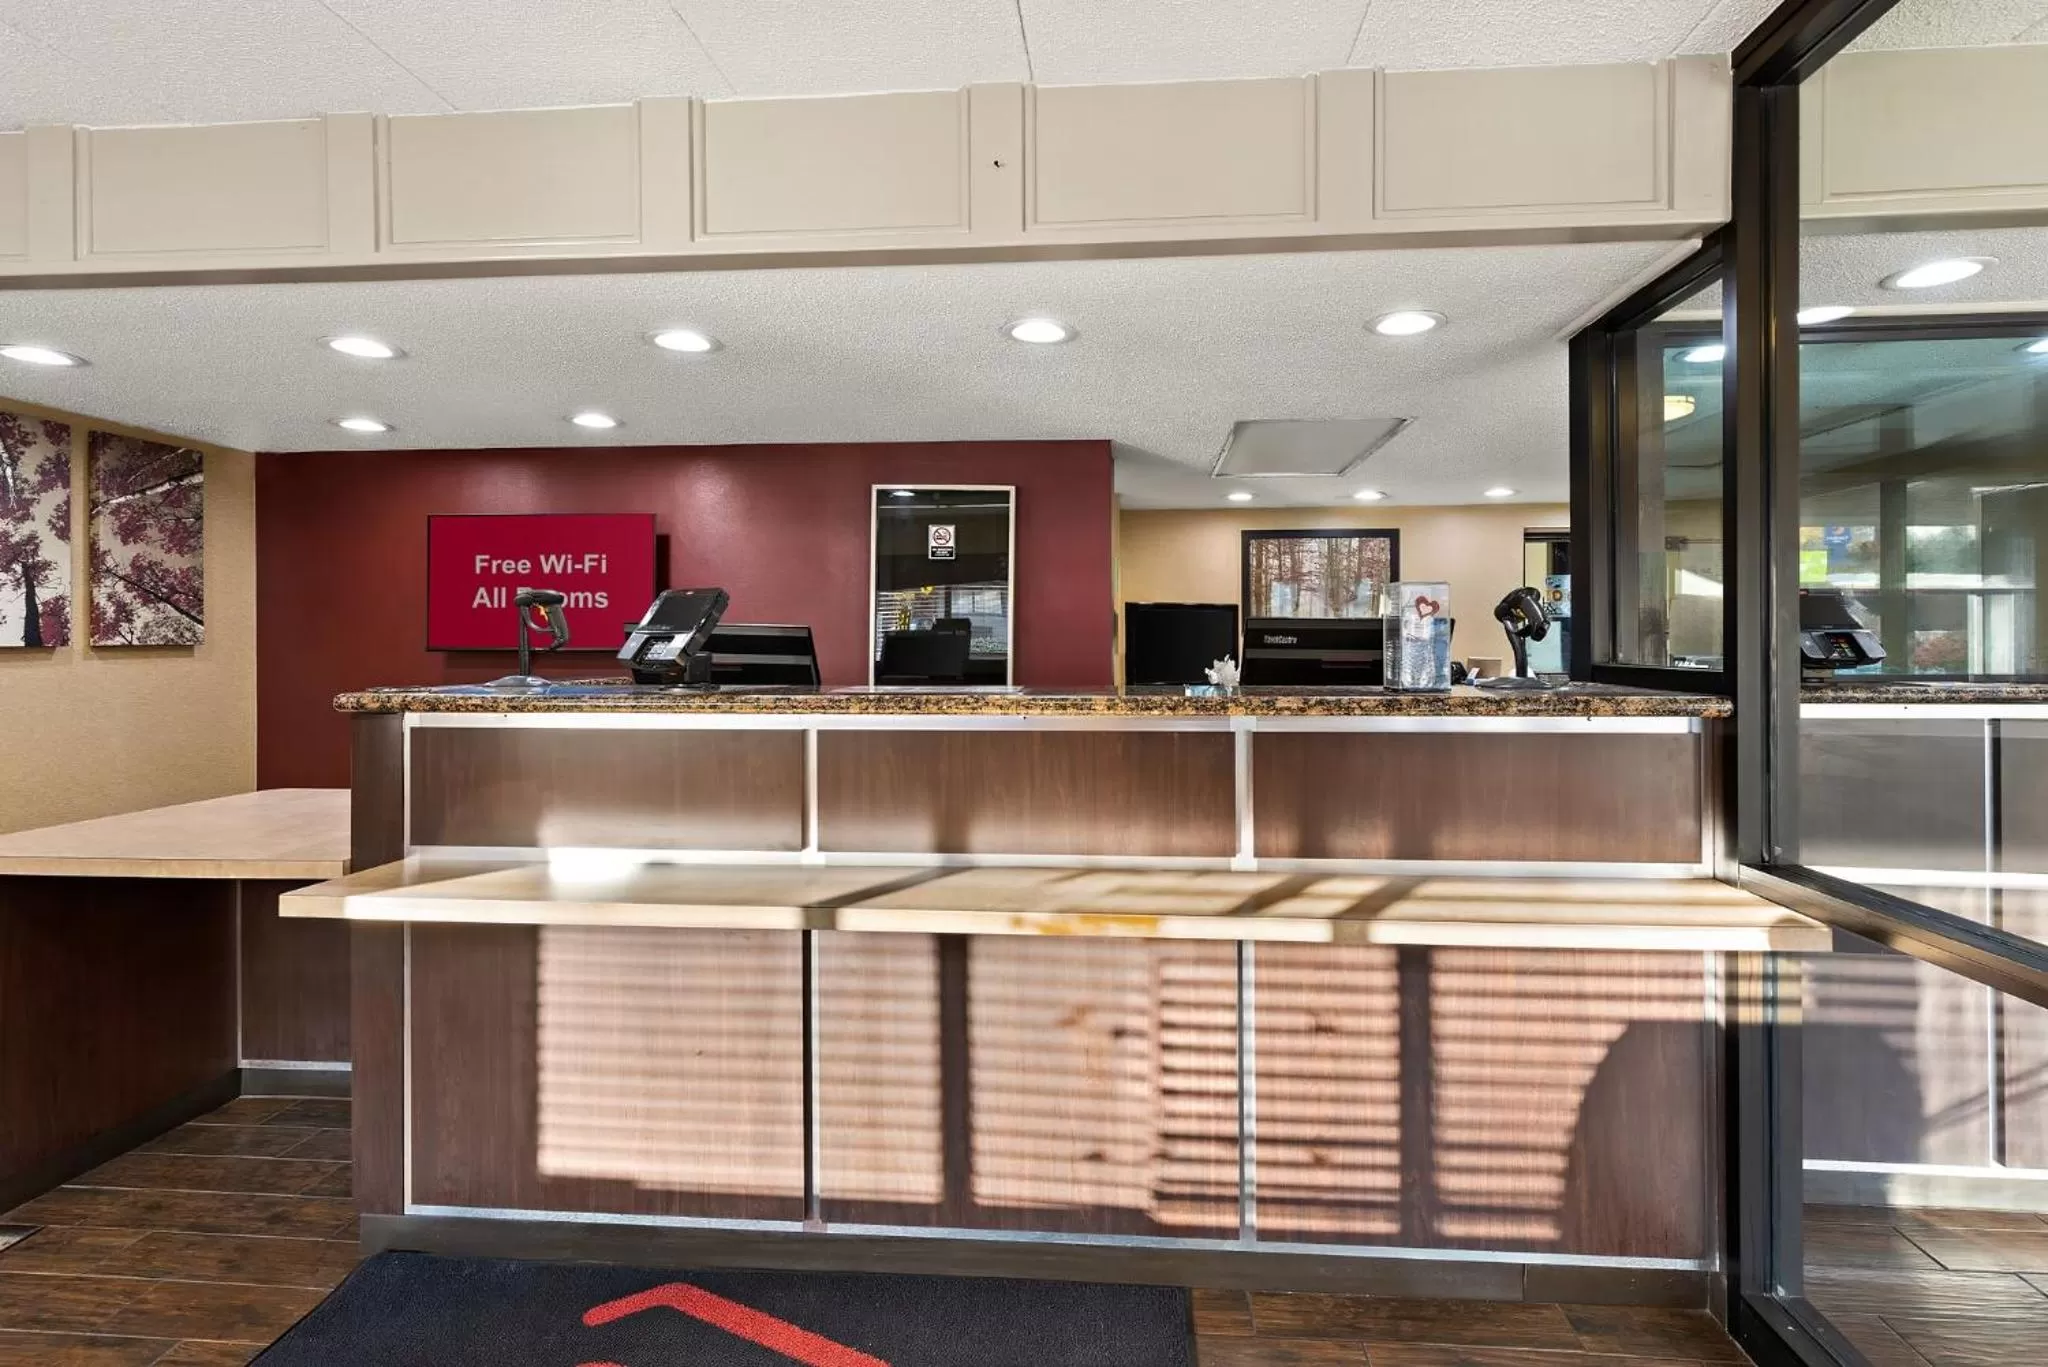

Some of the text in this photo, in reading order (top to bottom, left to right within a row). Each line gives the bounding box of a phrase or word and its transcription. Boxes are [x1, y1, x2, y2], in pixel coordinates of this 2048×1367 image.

[475, 553, 607, 575] Free Wi-Fi
[472, 586, 507, 609] All
